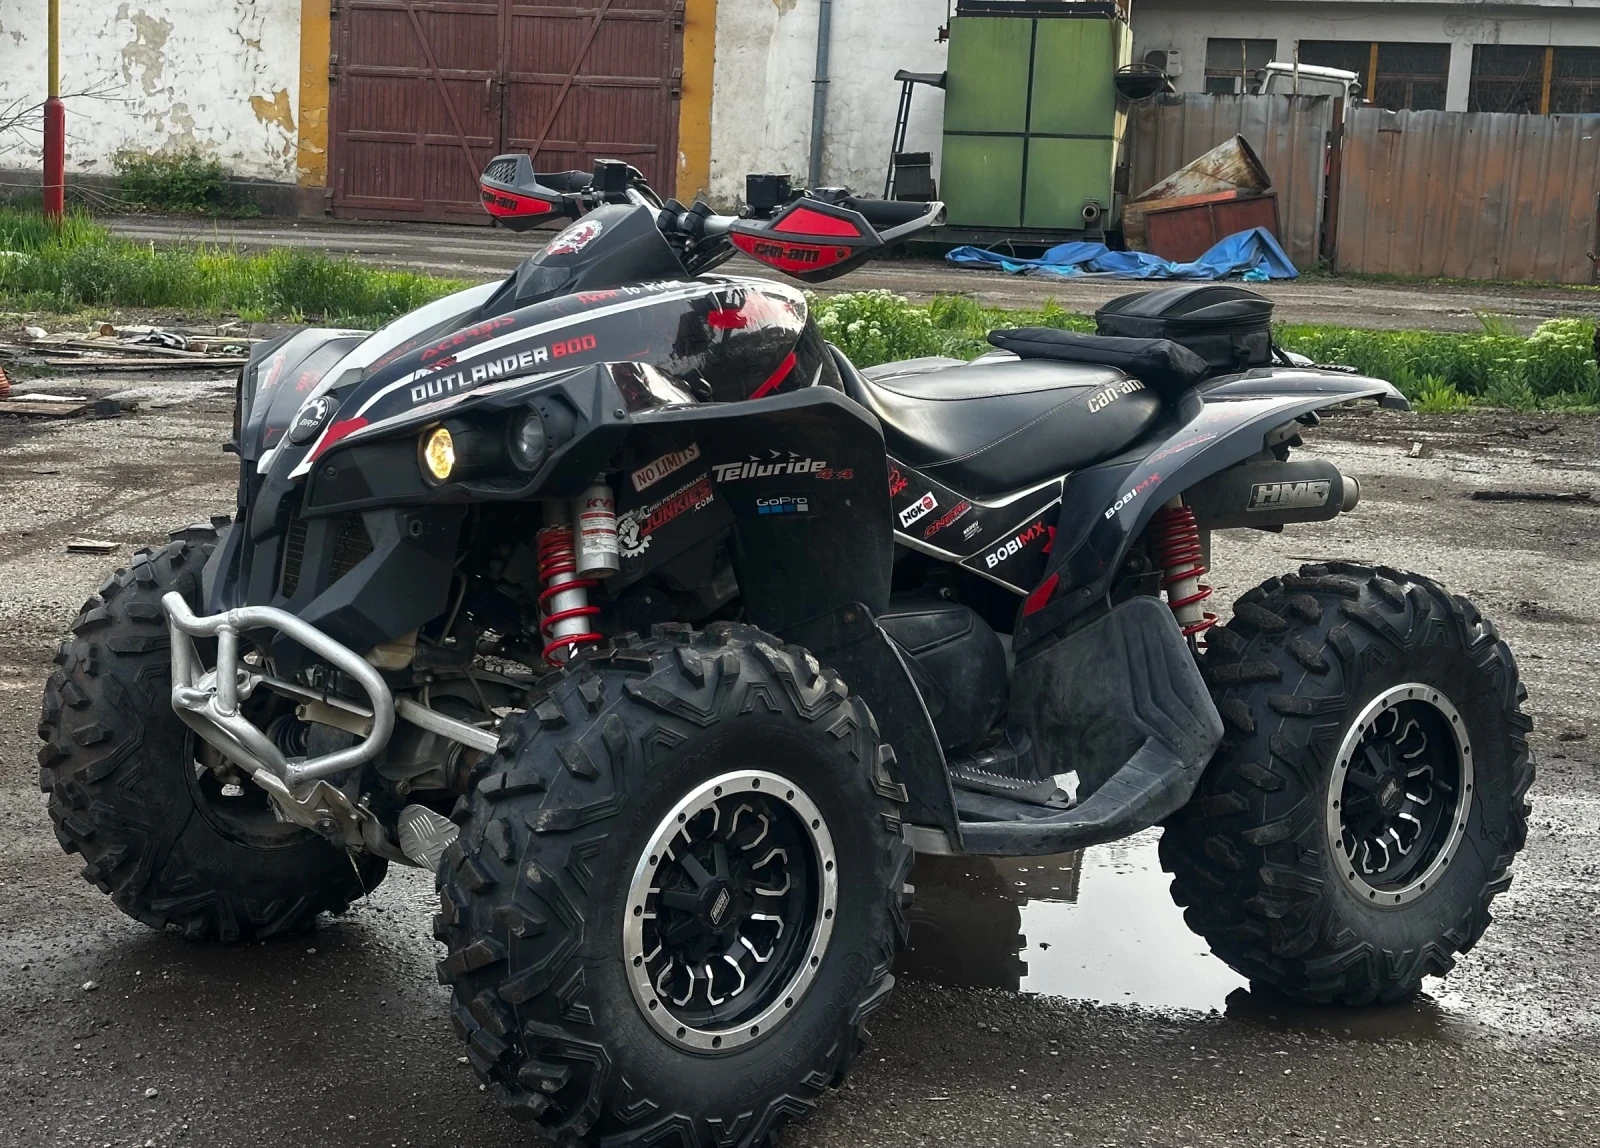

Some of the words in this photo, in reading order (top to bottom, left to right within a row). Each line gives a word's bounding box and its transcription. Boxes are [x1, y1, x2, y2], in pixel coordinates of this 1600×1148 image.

[753, 242, 820, 262] can-am
[621, 286, 640, 297] to
[410, 346, 550, 404] OUTLANDER
[551, 333, 597, 358] 800
[1086, 378, 1147, 414] can-am
[299, 418, 319, 428] BRP
[637, 467, 655, 487] NO
[656, 444, 699, 479] LIMITS
[712, 458, 827, 483] Telluride
[815, 468, 854, 480] 4x4
[662, 472, 709, 506] PERFORMANCE
[756, 496, 808, 507] GoPro
[1104, 472, 1162, 520] BOBIMX
[641, 481, 712, 536] JUNKIES
[902, 503, 925, 524] NGK
[985, 520, 1046, 569] BOBIMX
